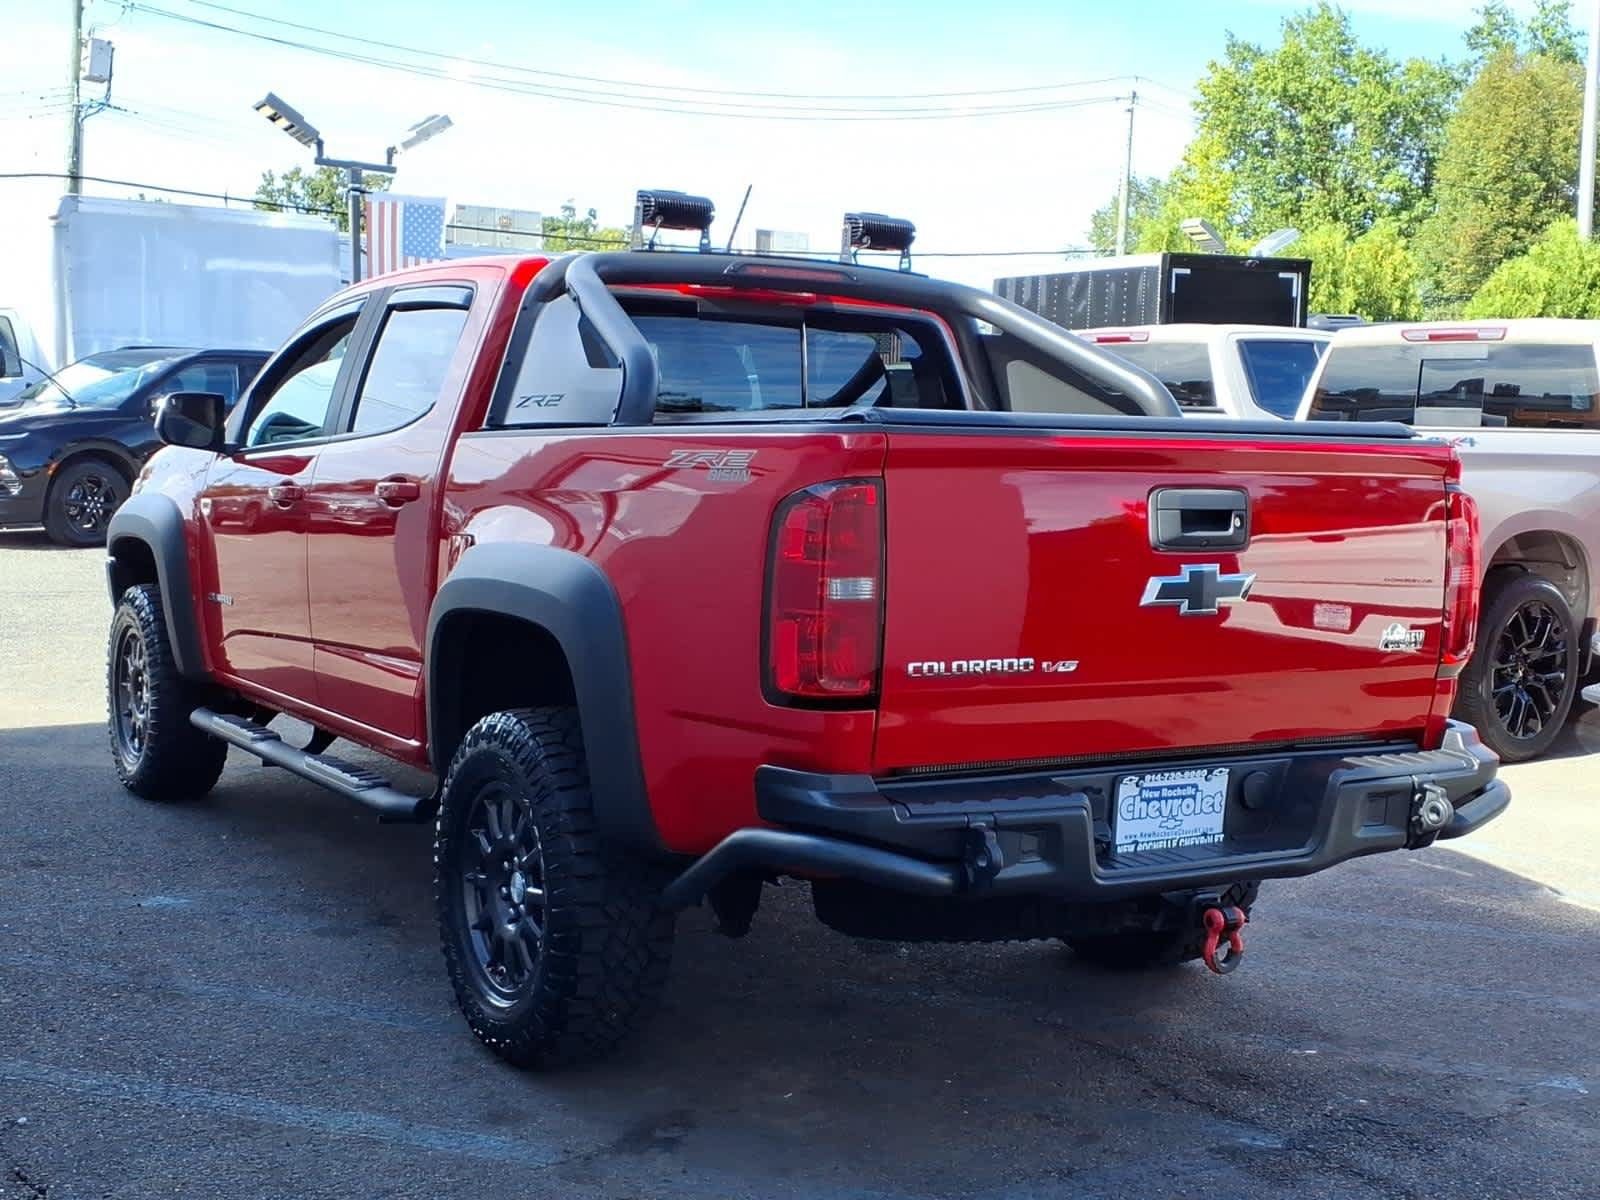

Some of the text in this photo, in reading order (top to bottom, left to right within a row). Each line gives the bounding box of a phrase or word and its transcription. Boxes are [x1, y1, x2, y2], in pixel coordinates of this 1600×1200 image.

[515, 393, 567, 408] ZR2
[662, 448, 758, 469] ZR2
[907, 658, 1035, 677] COLORADO
[1142, 785, 1196, 798] New Rochelle
[1120, 790, 1223, 821] Chevrolet
[1117, 843, 1136, 853] NEW
